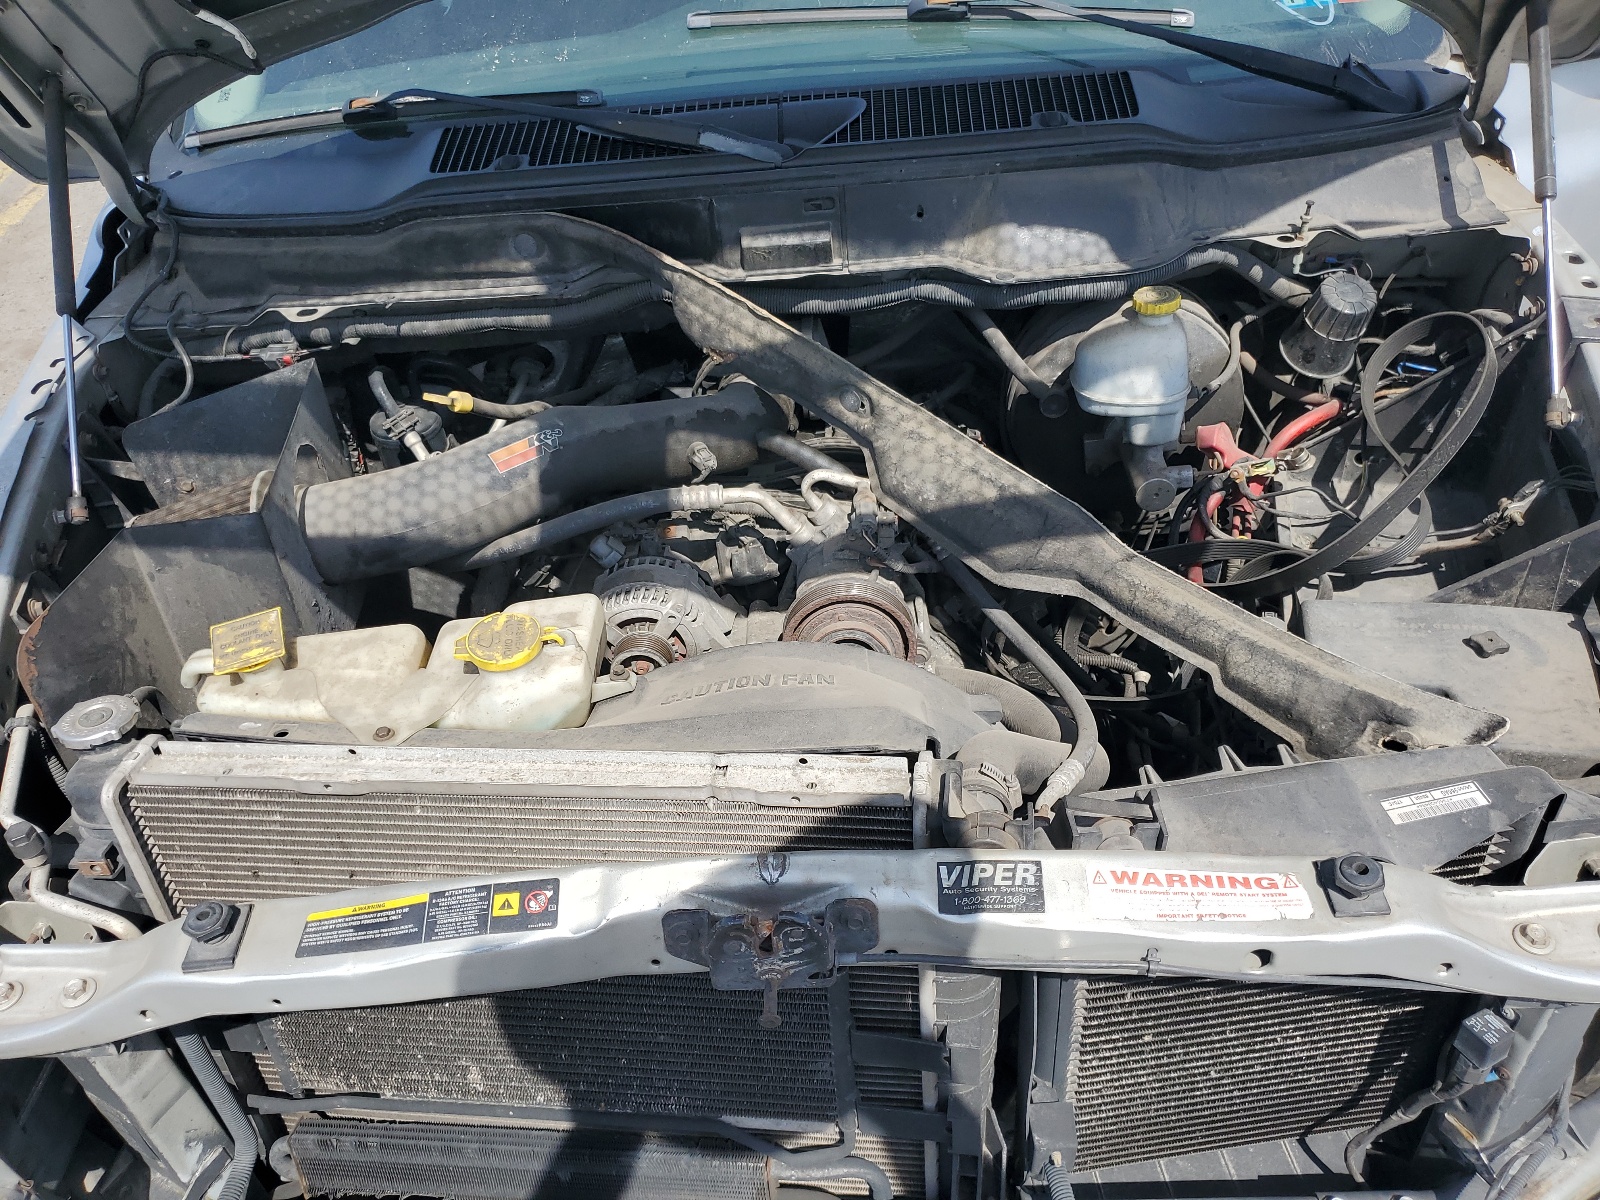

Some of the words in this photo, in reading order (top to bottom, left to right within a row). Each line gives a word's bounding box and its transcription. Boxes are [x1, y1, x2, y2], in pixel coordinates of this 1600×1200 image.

[661, 673, 771, 706] CAUTION
[781, 673, 835, 686] FAN
[938, 863, 1037, 888] VIPER
[1110, 870, 1280, 890] WARNING
[444, 887, 477, 897] ATTENTION
[964, 886, 998, 894] Security
[1000, 886, 1037, 894] Systems
[954, 895, 1027, 906] 1-800-477-1369
[357, 902, 387, 913] WARNING
